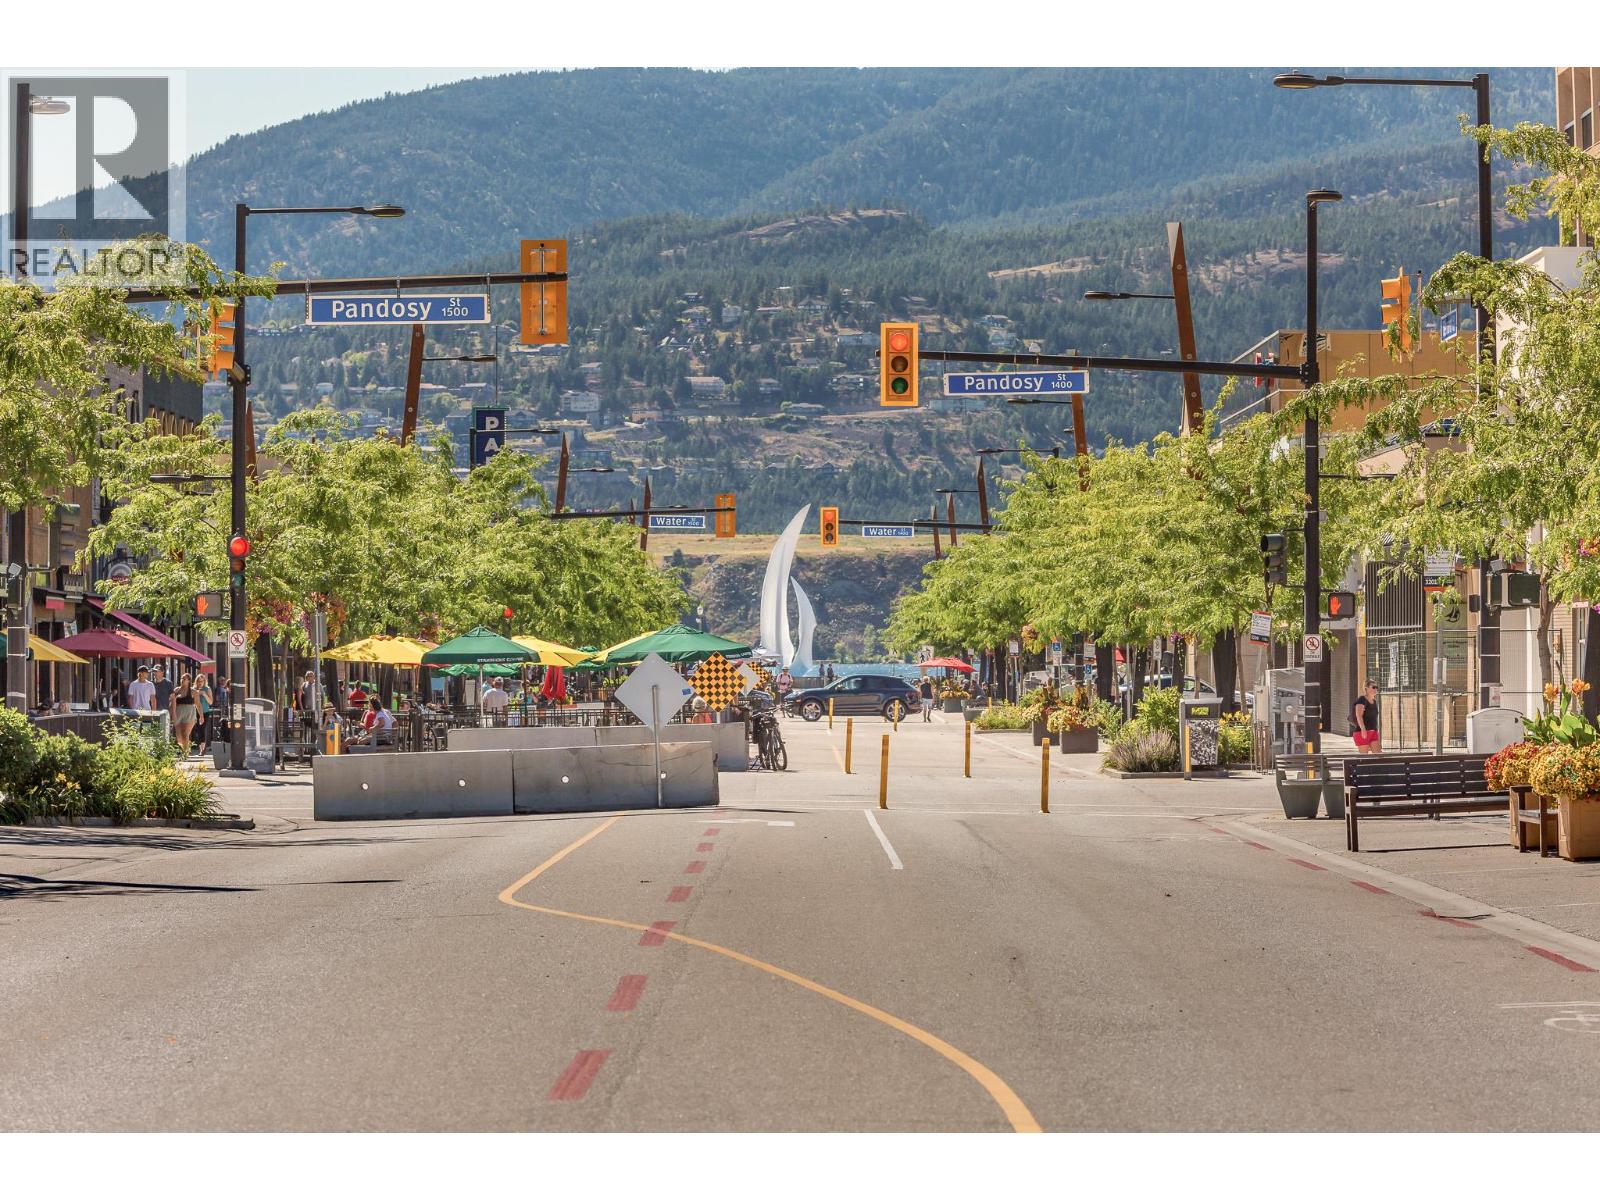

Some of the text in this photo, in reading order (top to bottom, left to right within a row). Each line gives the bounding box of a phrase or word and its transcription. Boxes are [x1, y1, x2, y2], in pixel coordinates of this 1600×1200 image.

[332, 297, 461, 320] Pandosy St
[442, 307, 469, 317] 1500
[964, 373, 1066, 391] Pandosy St
[1051, 381, 1072, 389] 1400
[656, 517, 686, 526] Water
[869, 527, 897, 536] Water
